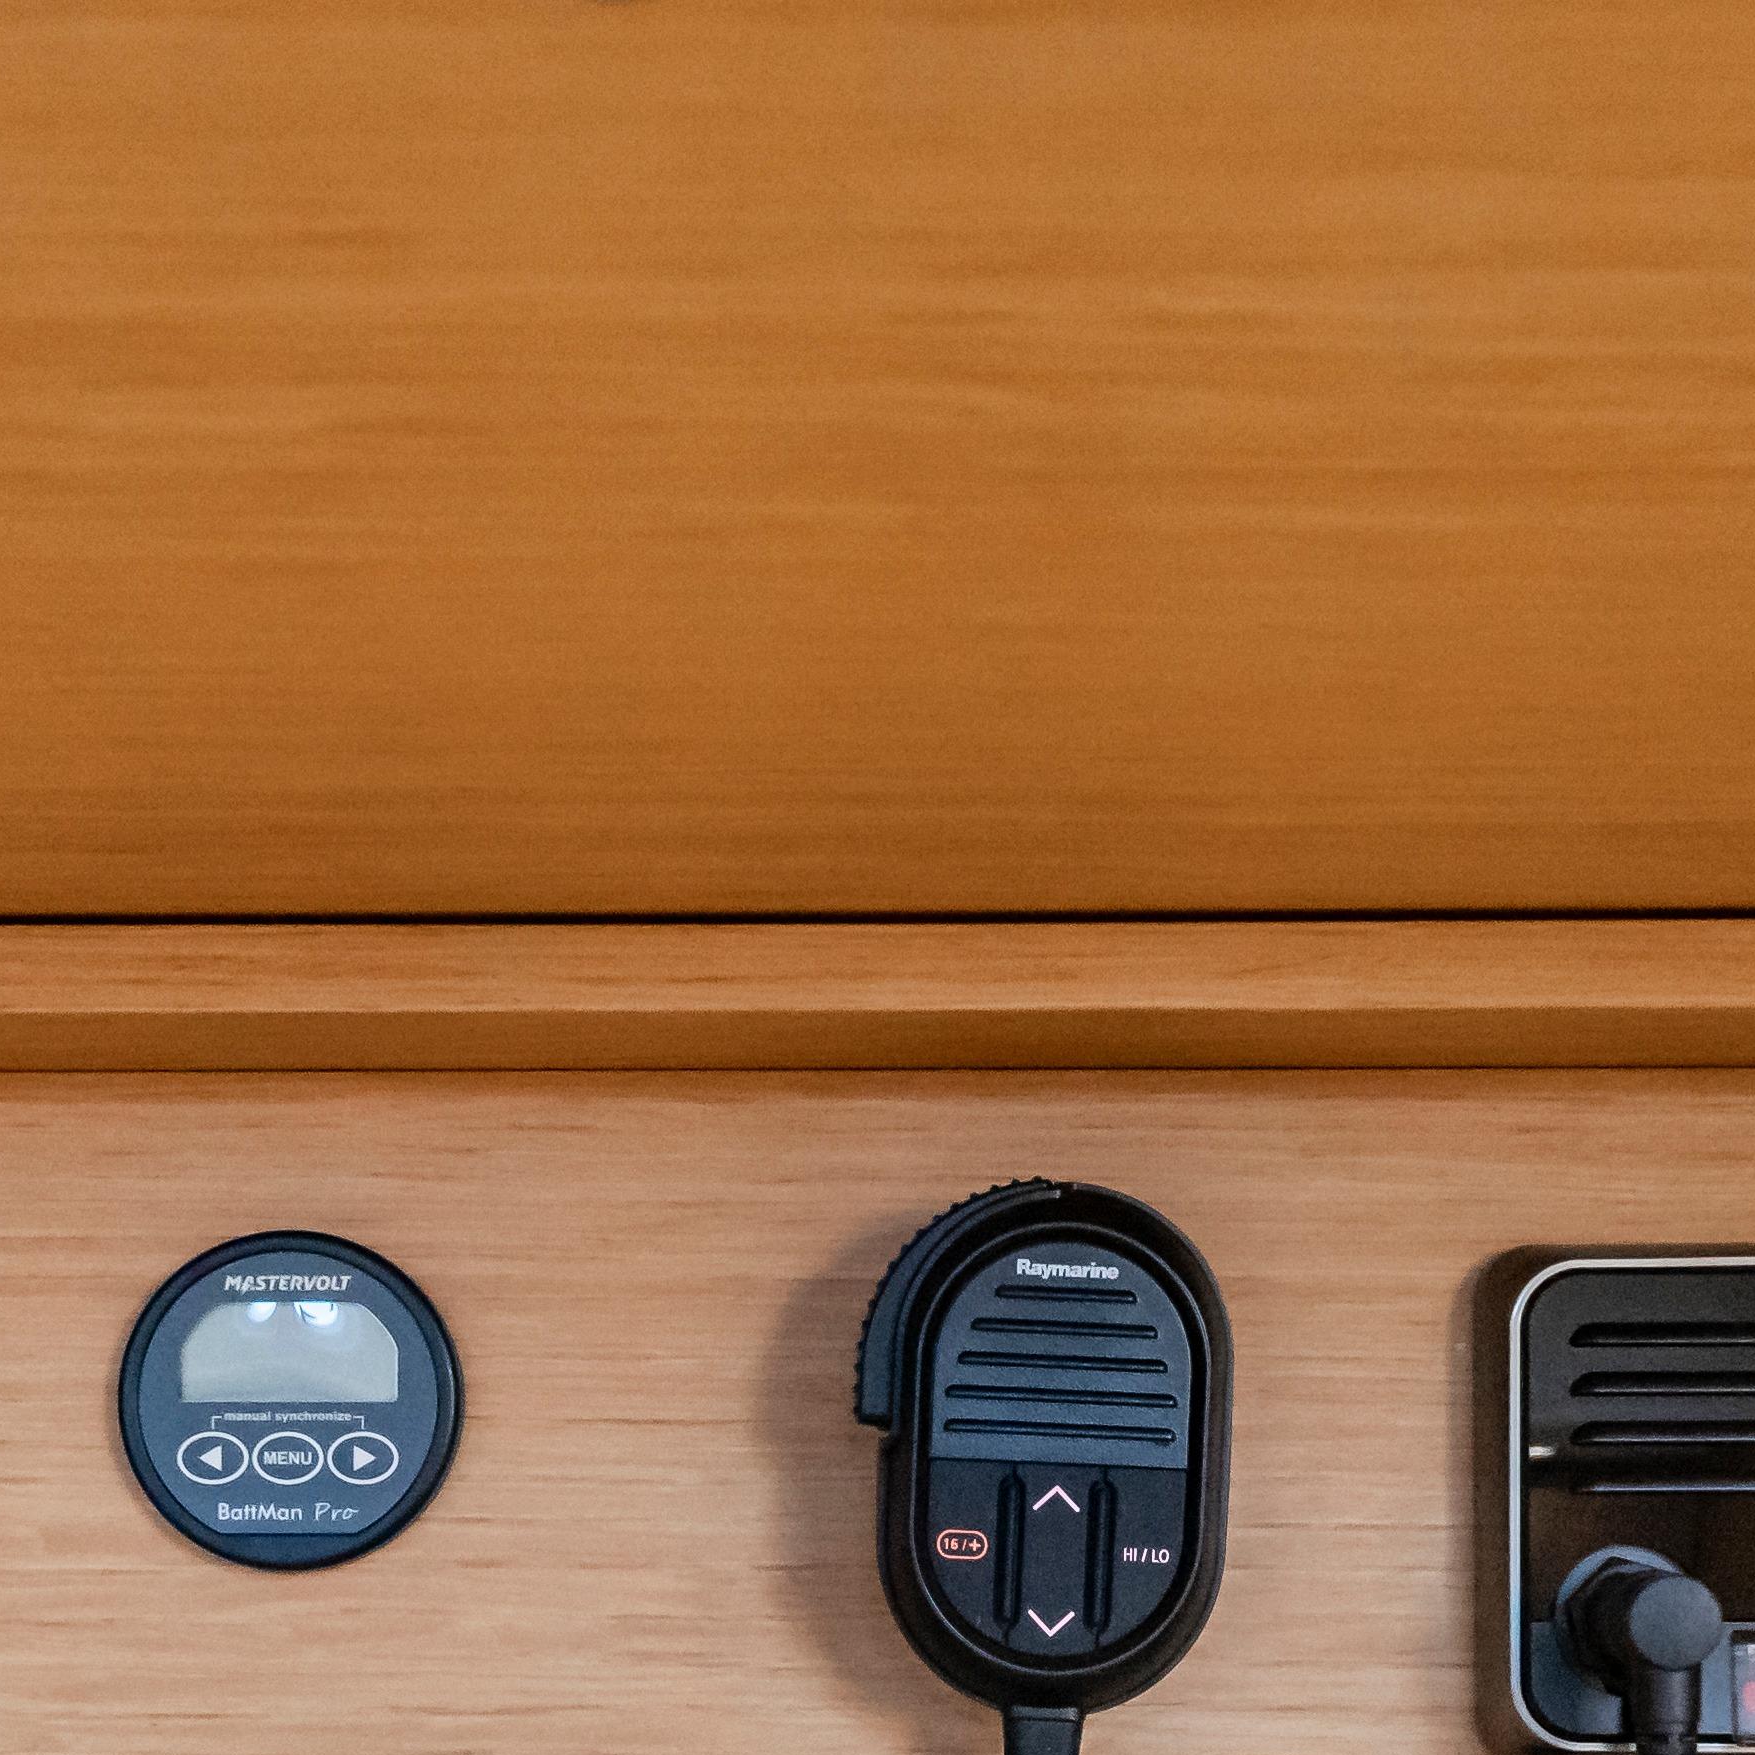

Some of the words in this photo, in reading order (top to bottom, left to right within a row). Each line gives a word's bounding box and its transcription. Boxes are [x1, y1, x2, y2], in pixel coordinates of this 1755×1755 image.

[1016, 1257, 1120, 1280] Raymarine
[224, 1274, 352, 1292] MASTERVOLT
[224, 1411, 271, 1421] manual
[275, 1411, 352, 1423] synchronize
[263, 1451, 313, 1466] MENU
[217, 1503, 302, 1521] BattMan
[314, 1502, 358, 1521] Pro
